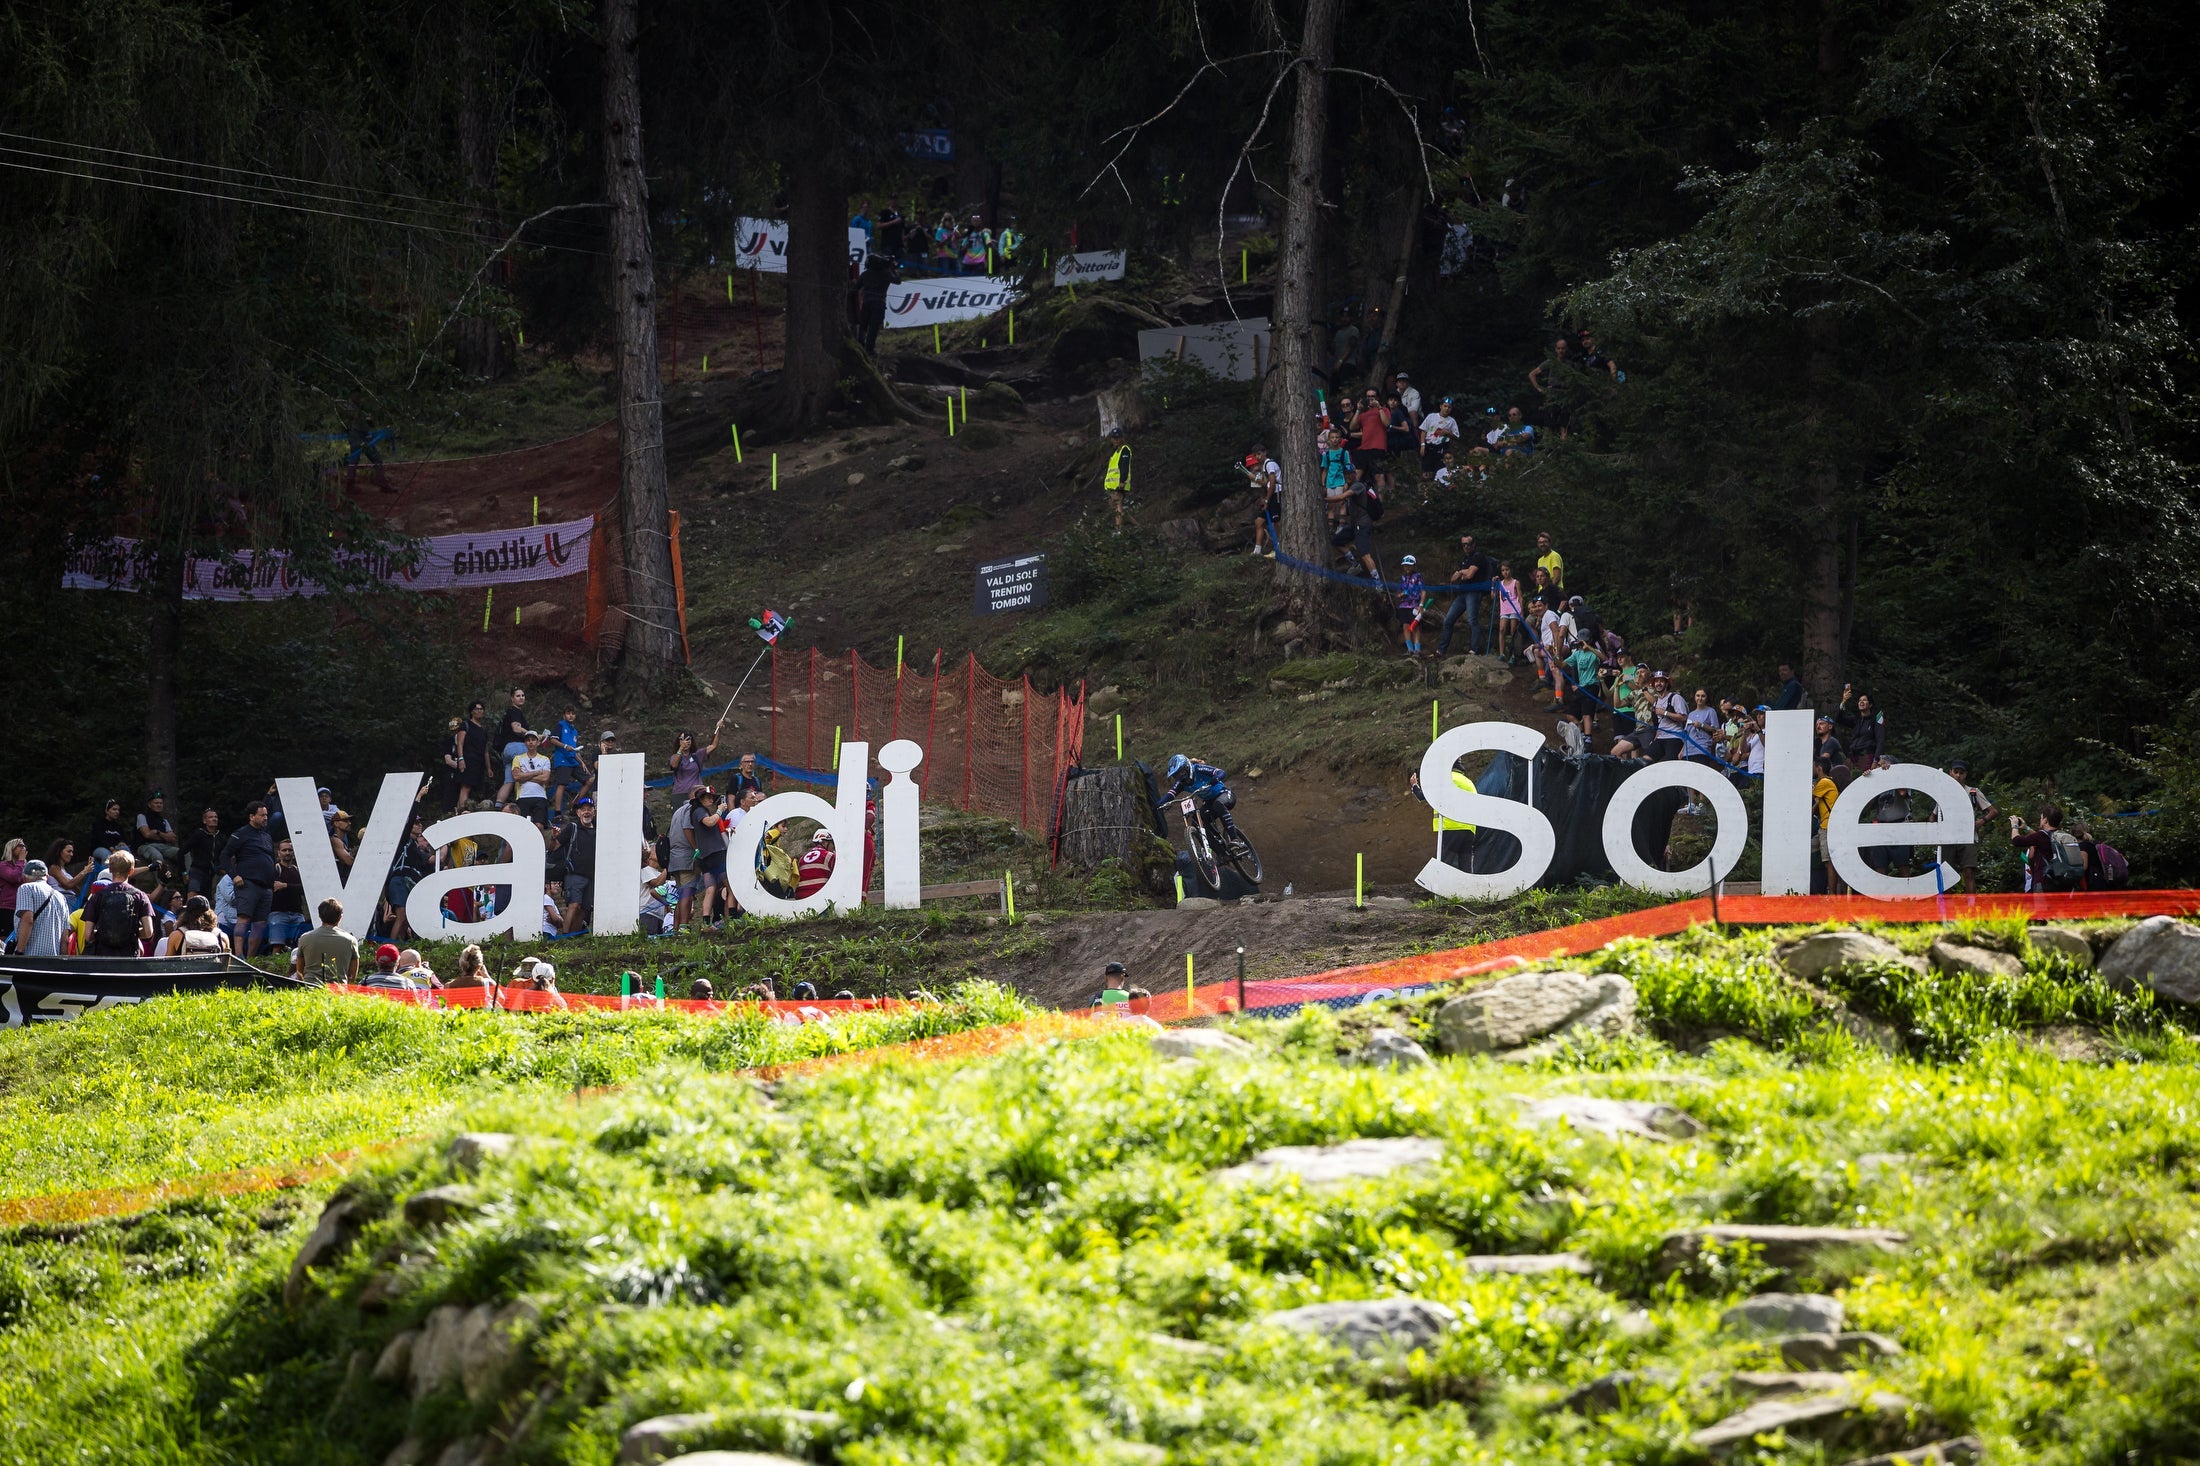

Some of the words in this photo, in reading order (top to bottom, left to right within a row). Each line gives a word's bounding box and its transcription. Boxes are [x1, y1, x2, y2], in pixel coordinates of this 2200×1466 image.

[986, 576, 1003, 588] VAL
[1005, 574, 1014, 584] DI
[1016, 569, 1038, 582] SOLE
[990, 582, 1032, 598] TRENTINO
[991, 594, 1031, 610] TOMBON
[275, 753, 645, 942] Val
[726, 739, 923, 918] di
[1415, 709, 1976, 902] Sole
